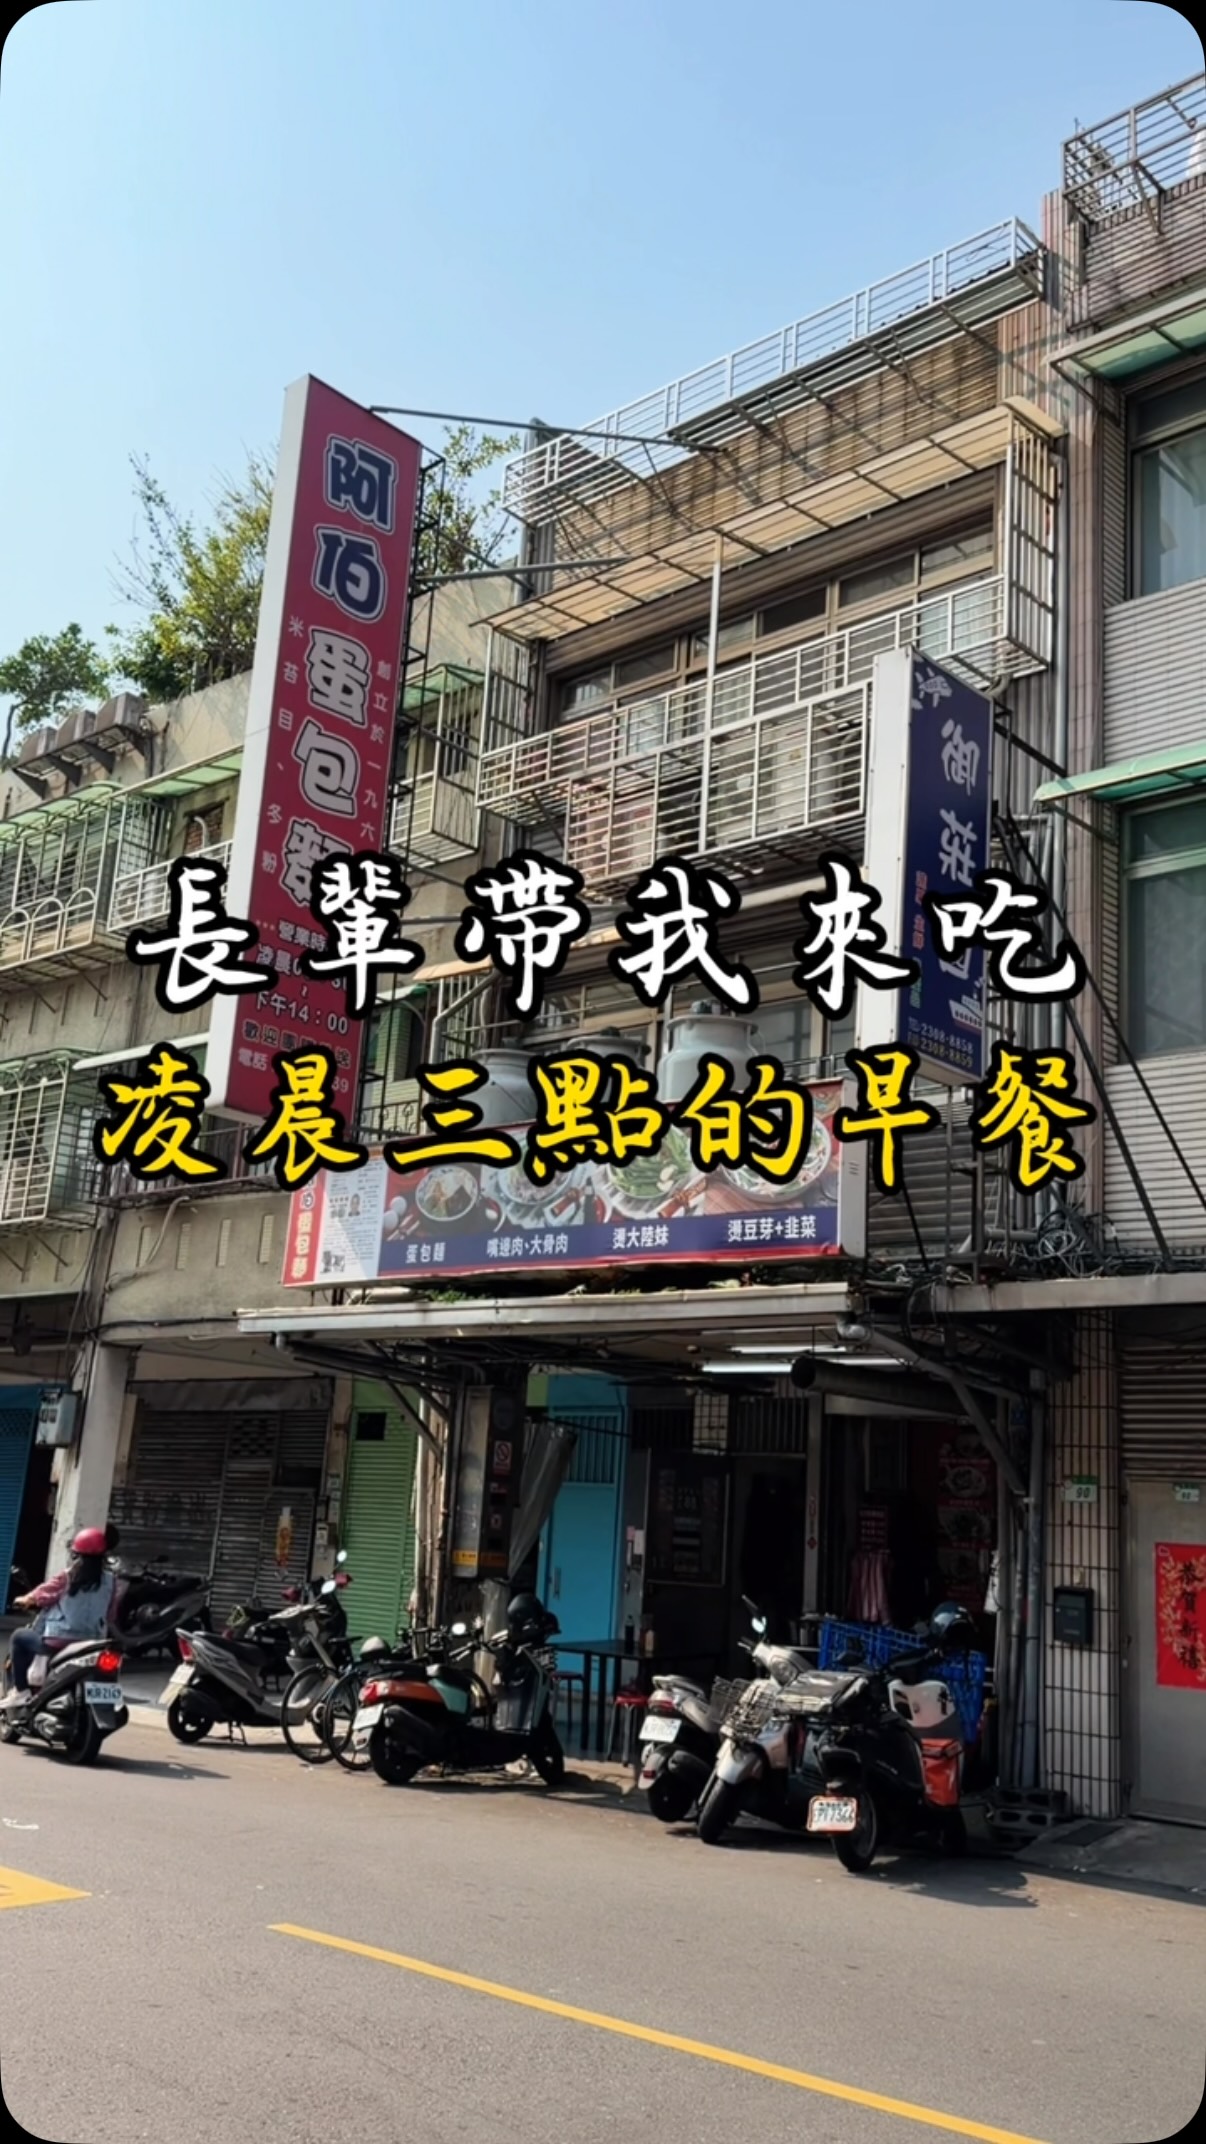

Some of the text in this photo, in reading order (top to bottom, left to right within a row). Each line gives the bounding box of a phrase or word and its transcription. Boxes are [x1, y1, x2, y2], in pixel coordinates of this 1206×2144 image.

[279, 920, 328, 952] 營業時
[612, 1225, 670, 1250] 燙大陸妹
